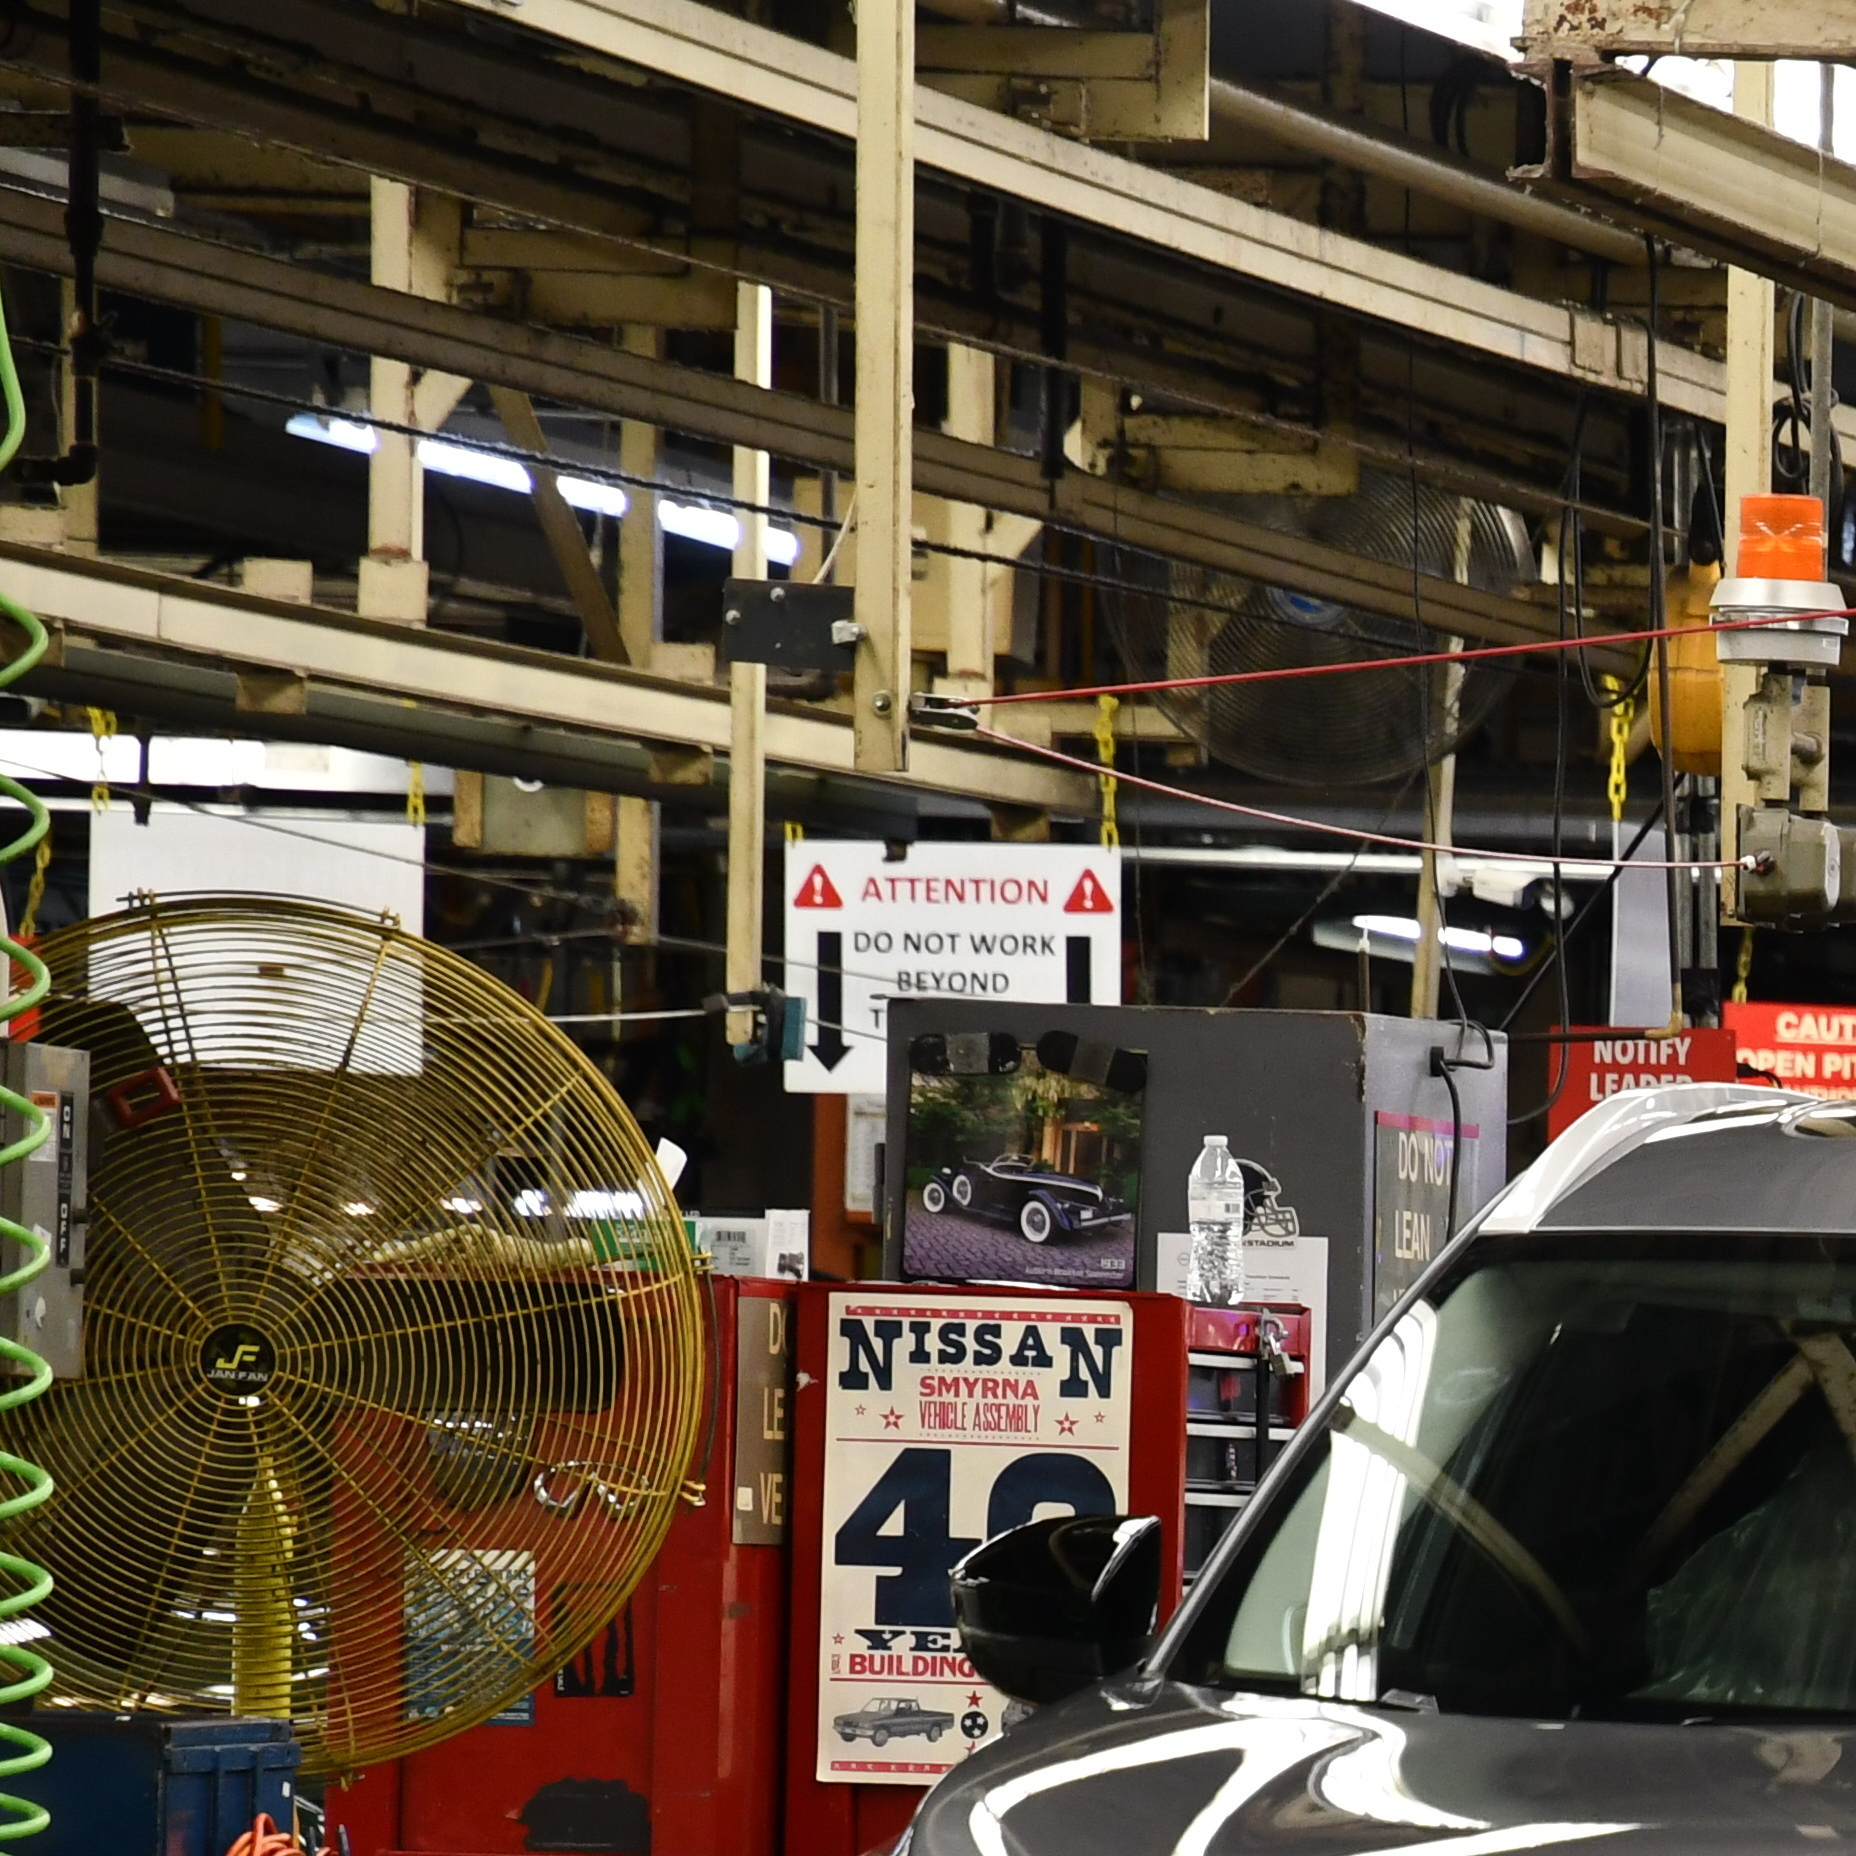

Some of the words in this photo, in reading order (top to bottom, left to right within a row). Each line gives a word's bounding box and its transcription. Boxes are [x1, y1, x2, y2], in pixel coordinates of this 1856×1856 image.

[862, 876, 1049, 905] ATTENTION
[854, 931, 893, 954] DO
[904, 933, 962, 955] NOT
[970, 934, 1057, 957] WORK
[897, 971, 1010, 995] BEYOND
[1593, 1036, 1692, 1066] NOTIFY
[1737, 1047, 1817, 1080] OPEN
[1398, 1131, 1419, 1182] DO
[1394, 1209, 1431, 1263] LEAN
[838, 1318, 1123, 1400] NISSAN
[919, 1375, 1040, 1401] SMYRNA
[919, 1400, 968, 1431] VEHICLE
[972, 1402, 1041, 1434] ASSEMBLY
[848, 1653, 976, 1679] BUILDING
